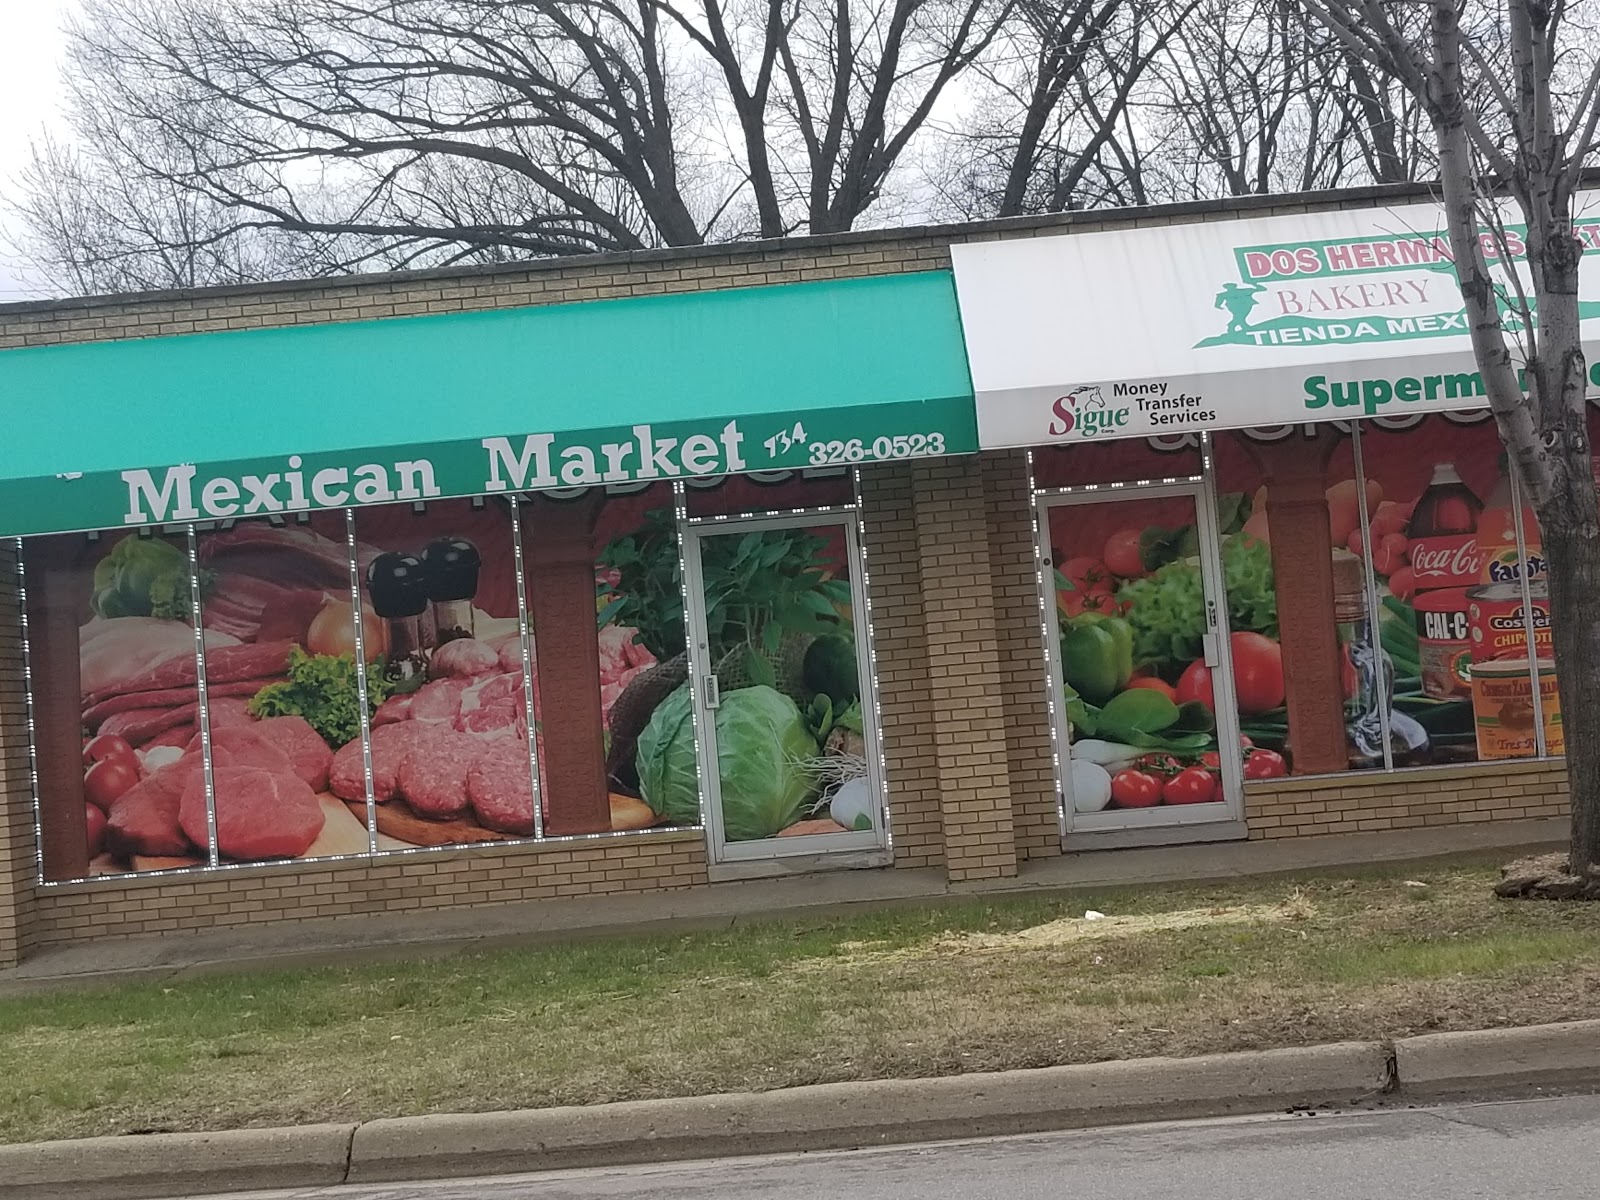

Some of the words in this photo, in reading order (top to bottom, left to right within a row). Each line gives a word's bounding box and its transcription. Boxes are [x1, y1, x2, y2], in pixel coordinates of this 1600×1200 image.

[1245, 248, 1321, 277] DOS
[1325, 231, 1526, 270] HERMAOS
[1276, 278, 1429, 315] BAKERY
[1246, 321, 1380, 345] TIENDA
[1113, 382, 1168, 397] Money
[1136, 394, 1202, 411] Transfer
[1048, 396, 1130, 437] Sigue
[1150, 409, 1216, 426] Services
[121, 455, 441, 524] Mexican
[481, 419, 746, 491] Market
[808, 432, 946, 465] 326-0523
